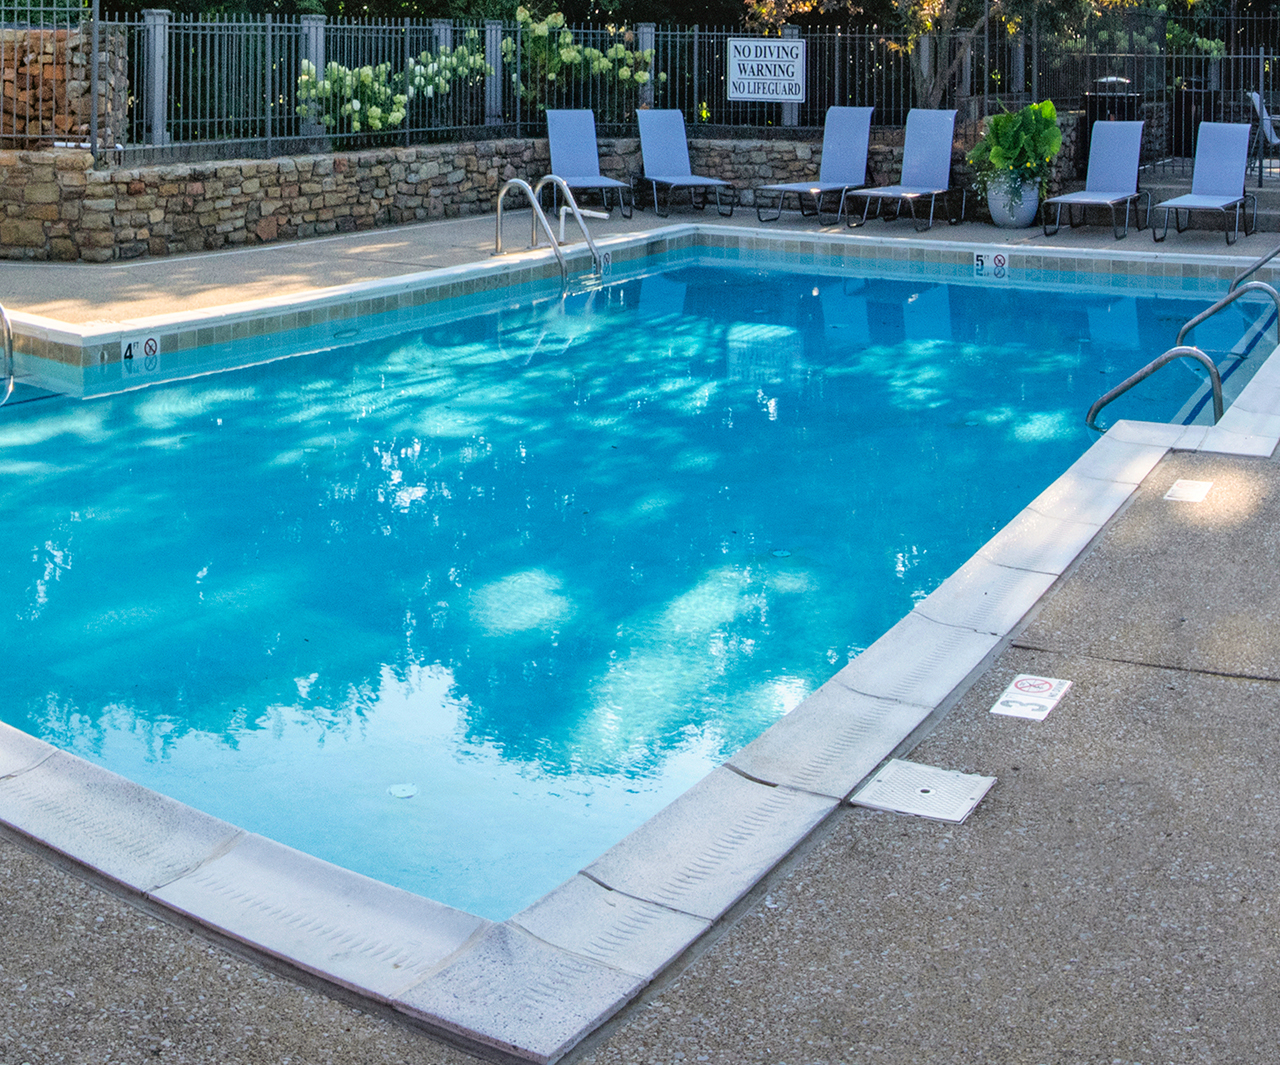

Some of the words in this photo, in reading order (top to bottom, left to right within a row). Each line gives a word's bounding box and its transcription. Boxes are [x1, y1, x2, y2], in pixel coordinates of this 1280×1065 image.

[733, 45, 751, 58] NO
[754, 45, 799, 59] DIVING
[737, 63, 795, 78] WARNING
[732, 81, 745, 94] NO
[747, 81, 801, 96] LIFEGUARD
[976, 254, 984, 267] 5
[124, 342, 133, 360] 4
[133, 341, 139, 349] FT
[1000, 700, 1048, 712] 3
